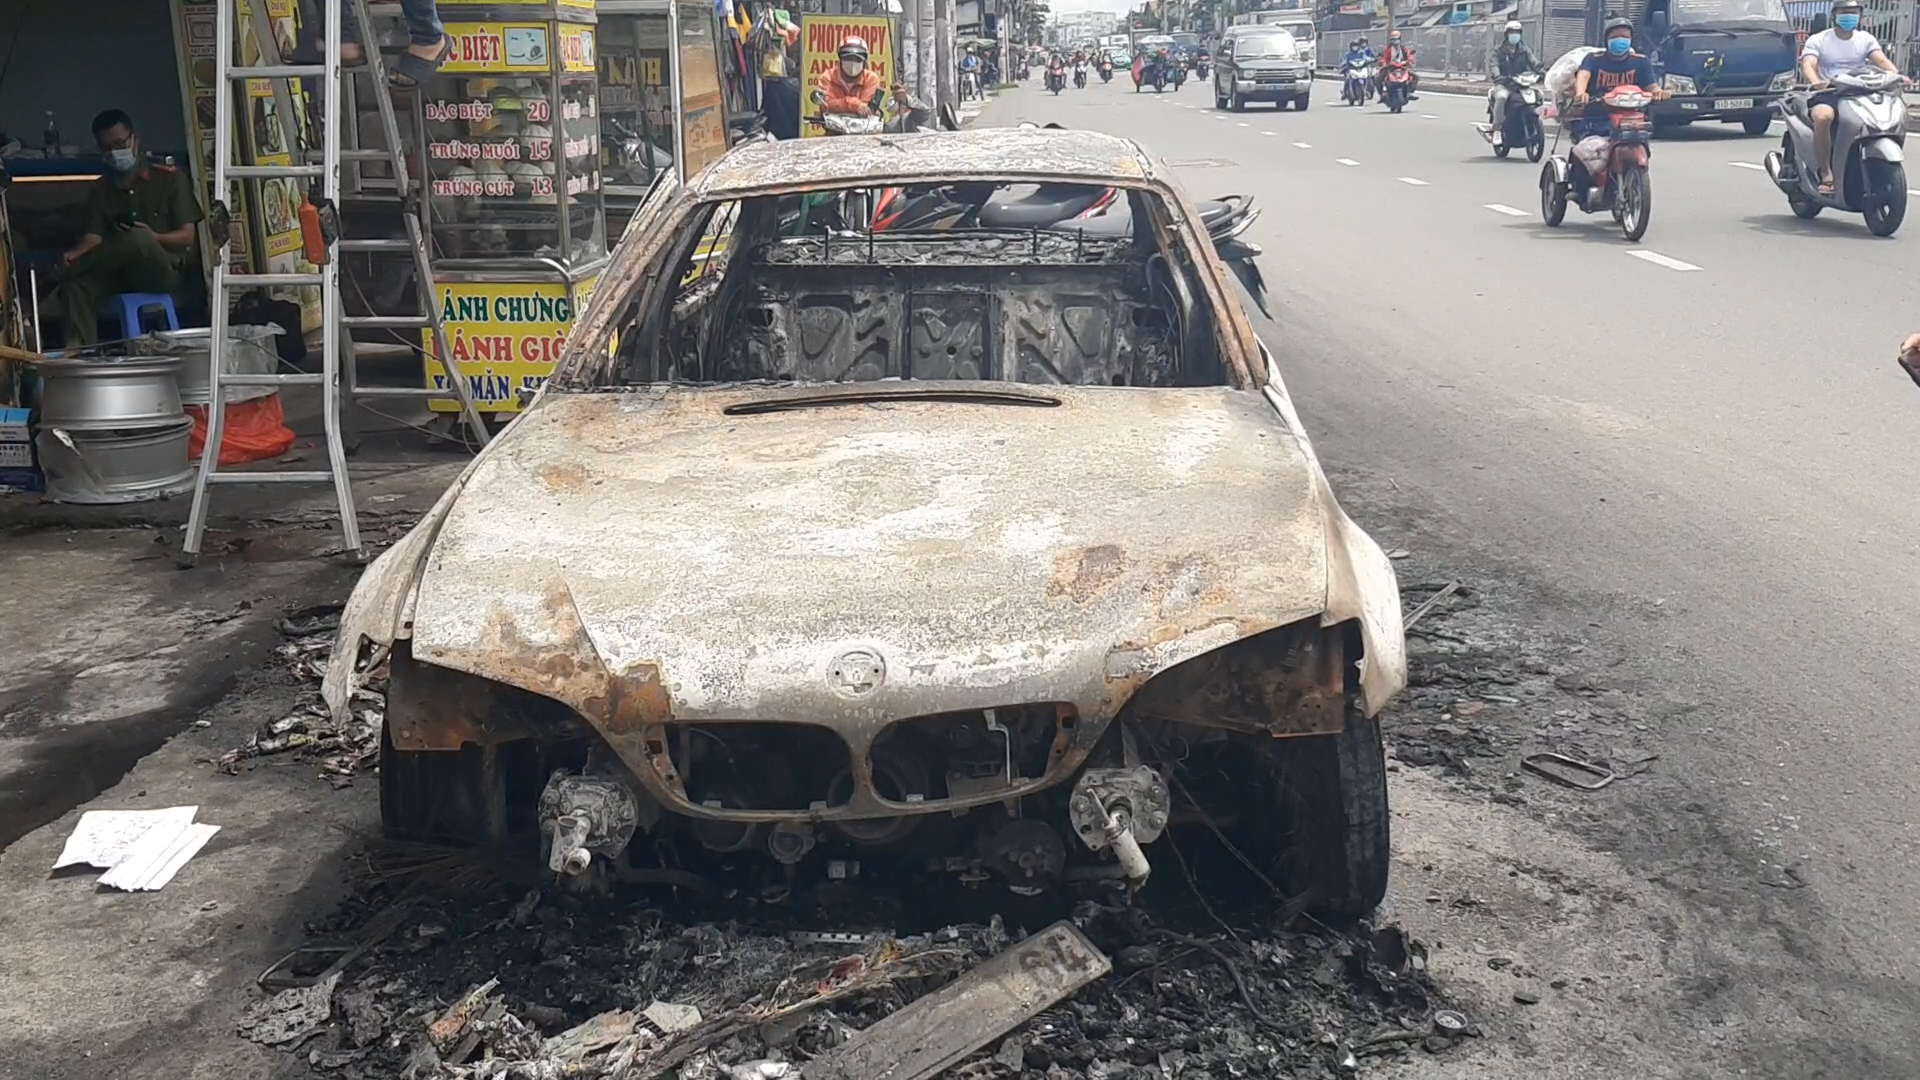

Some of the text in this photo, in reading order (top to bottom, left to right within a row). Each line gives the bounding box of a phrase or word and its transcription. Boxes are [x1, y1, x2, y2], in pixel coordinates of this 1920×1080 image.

[462, 27, 500, 67] BIỆT
[426, 101, 457, 122] ĐẶC
[459, 100, 493, 122] BIỆT
[527, 101, 550, 121] 20
[430, 139, 480, 159] TRỨNG
[482, 138, 520, 159] MUỐI
[529, 141, 551, 160] 15
[433, 178, 483, 196] TRỨNG
[485, 177, 514, 196] CÚT
[532, 177, 553, 196] 13
[494, 291, 569, 322] CHƯNG
[470, 368, 510, 406] MẶN
